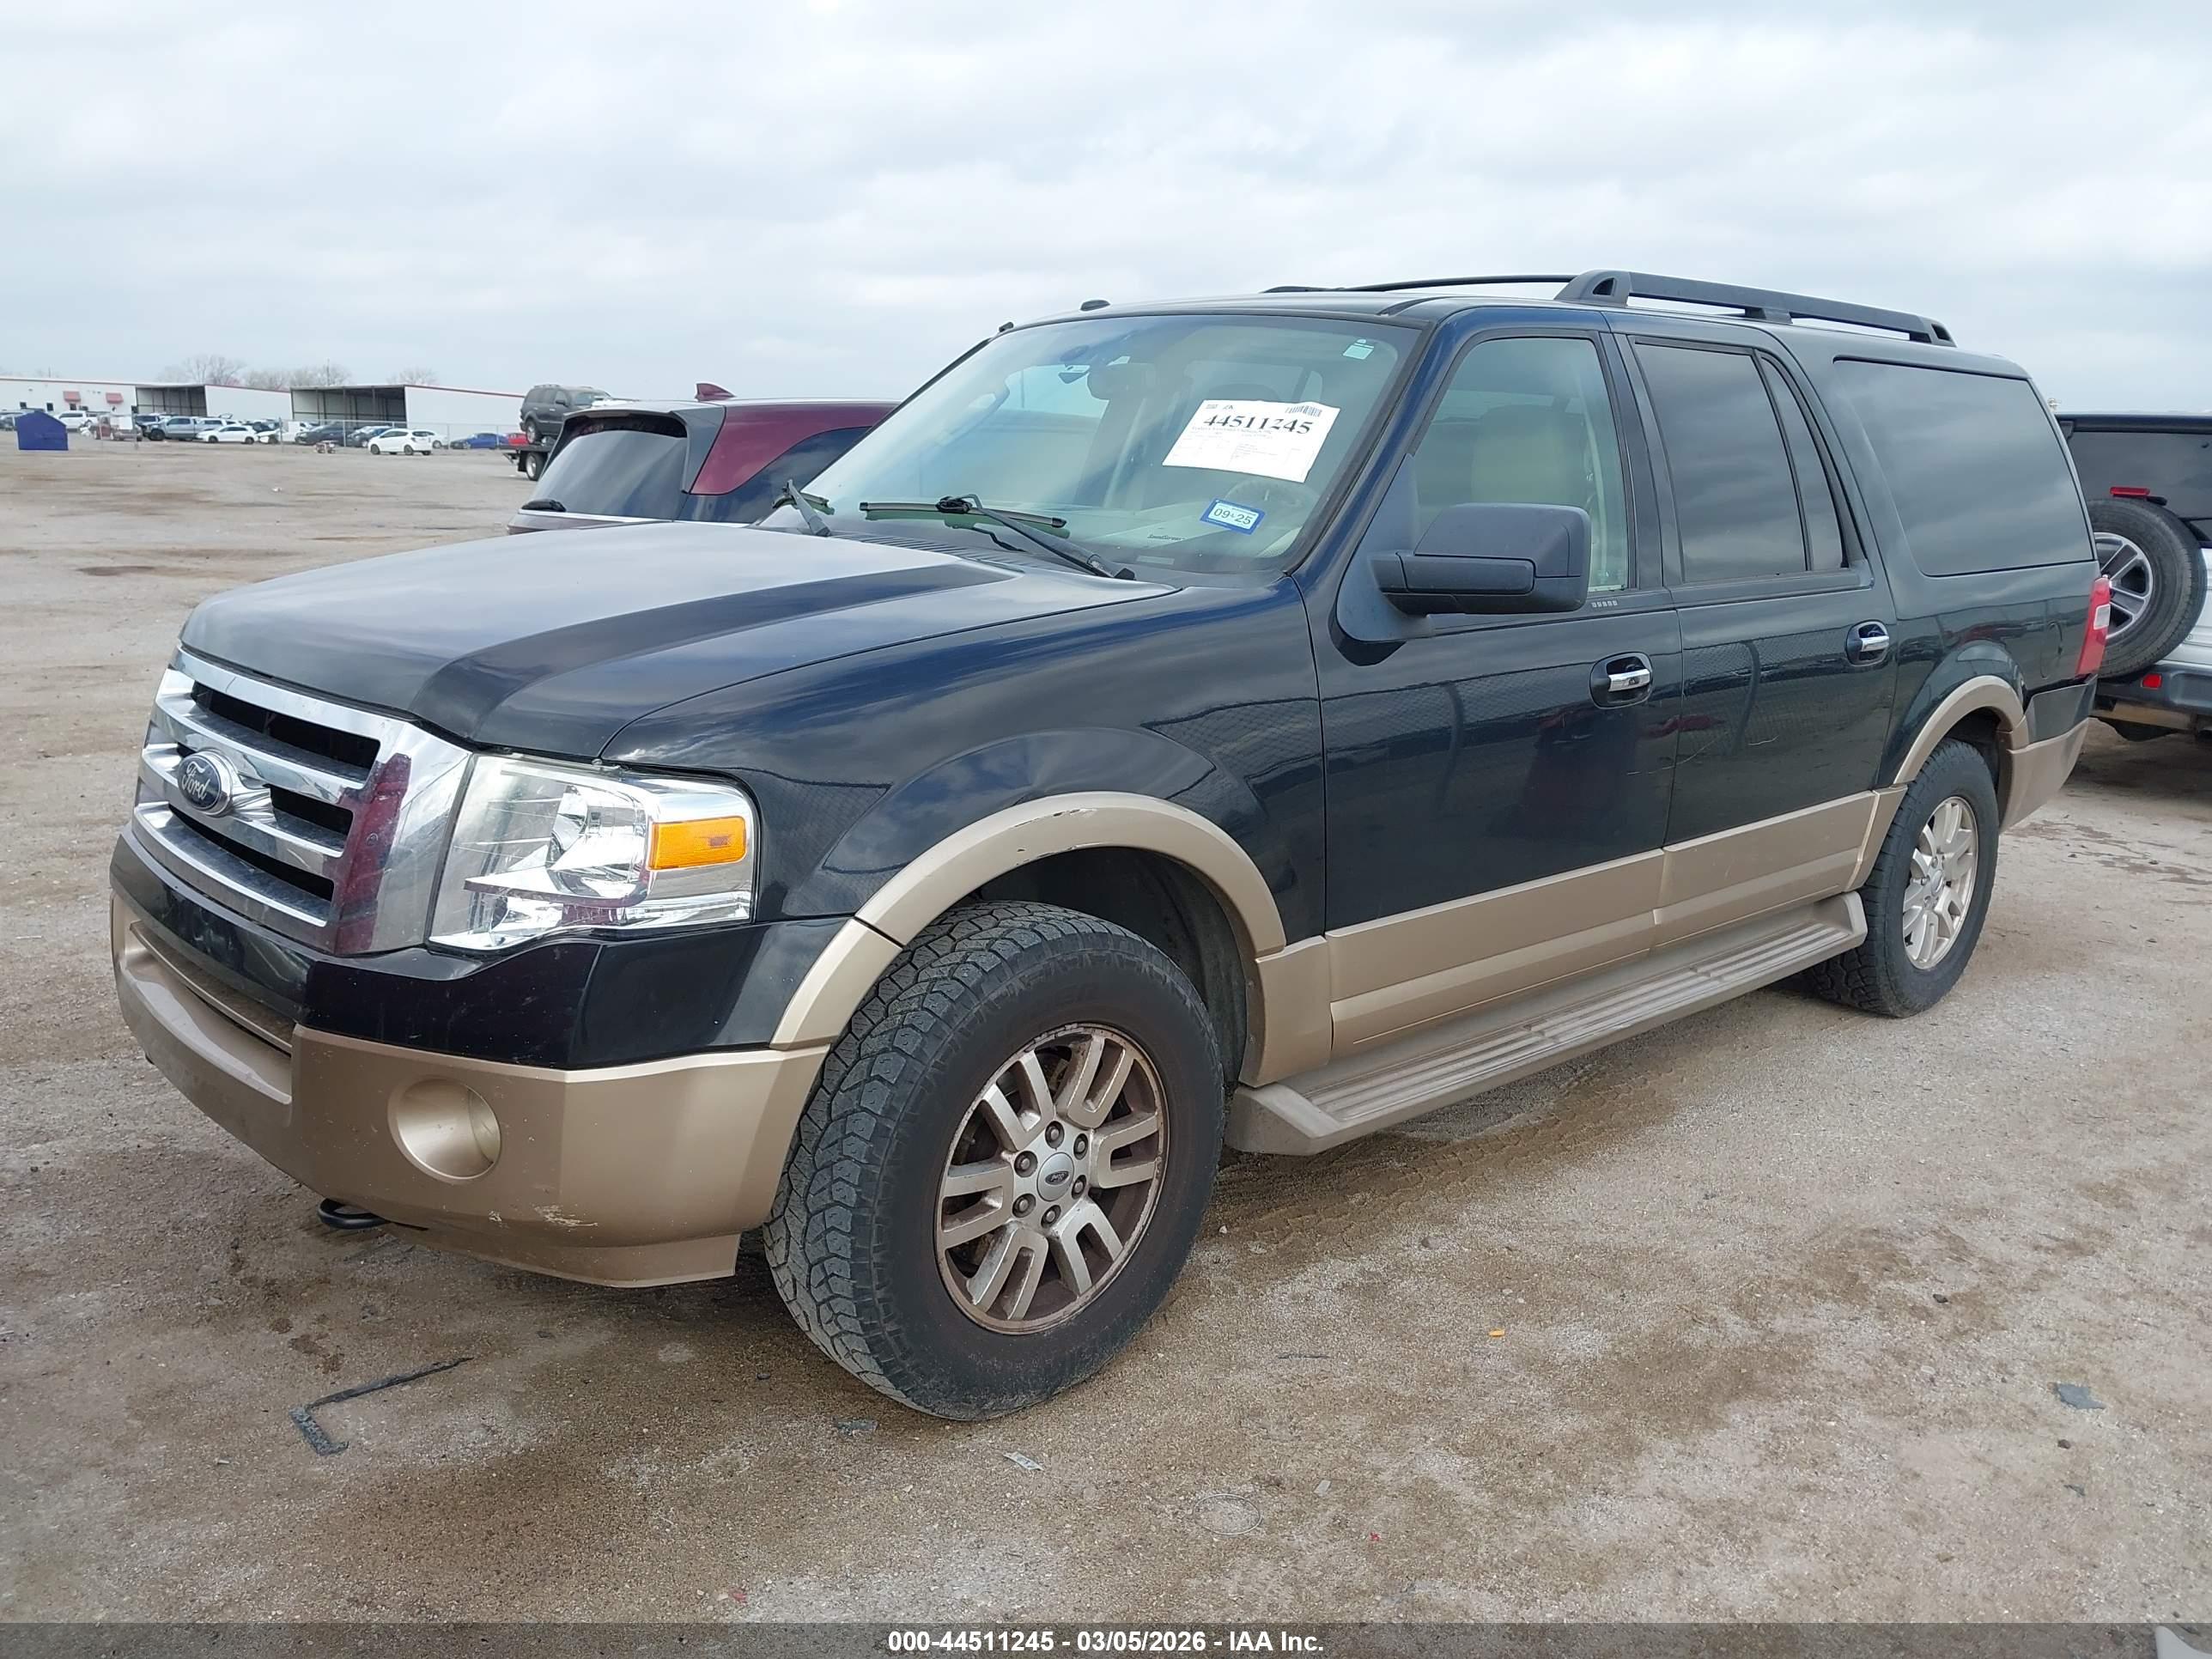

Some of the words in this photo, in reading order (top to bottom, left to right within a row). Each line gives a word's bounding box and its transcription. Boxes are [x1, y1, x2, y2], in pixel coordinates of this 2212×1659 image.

[1204, 415, 1313, 434] 44511245
[1213, 507, 1231, 519] 09
[1235, 514, 1254, 525] 25
[181, 761, 210, 800] Ford
